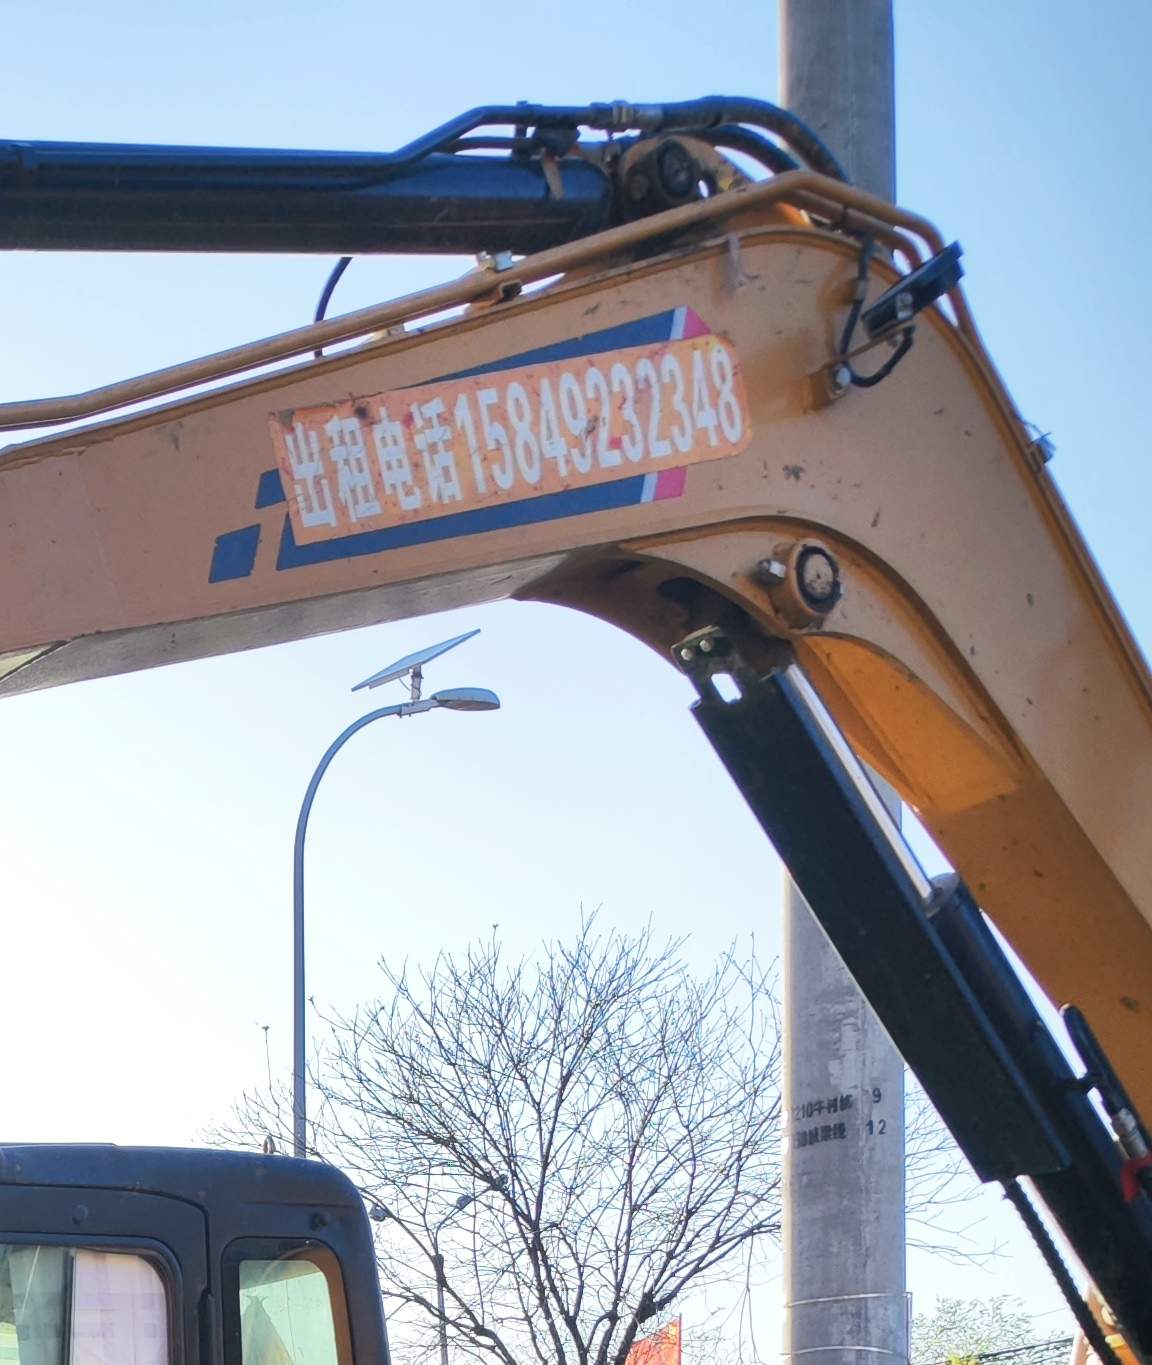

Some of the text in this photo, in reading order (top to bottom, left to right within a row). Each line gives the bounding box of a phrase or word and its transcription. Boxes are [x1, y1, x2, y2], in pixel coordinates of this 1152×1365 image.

[285, 345, 743, 528] 出租电话15849232348
[872, 1087, 881, 1103] 9
[866, 1119, 886, 1135] 12
